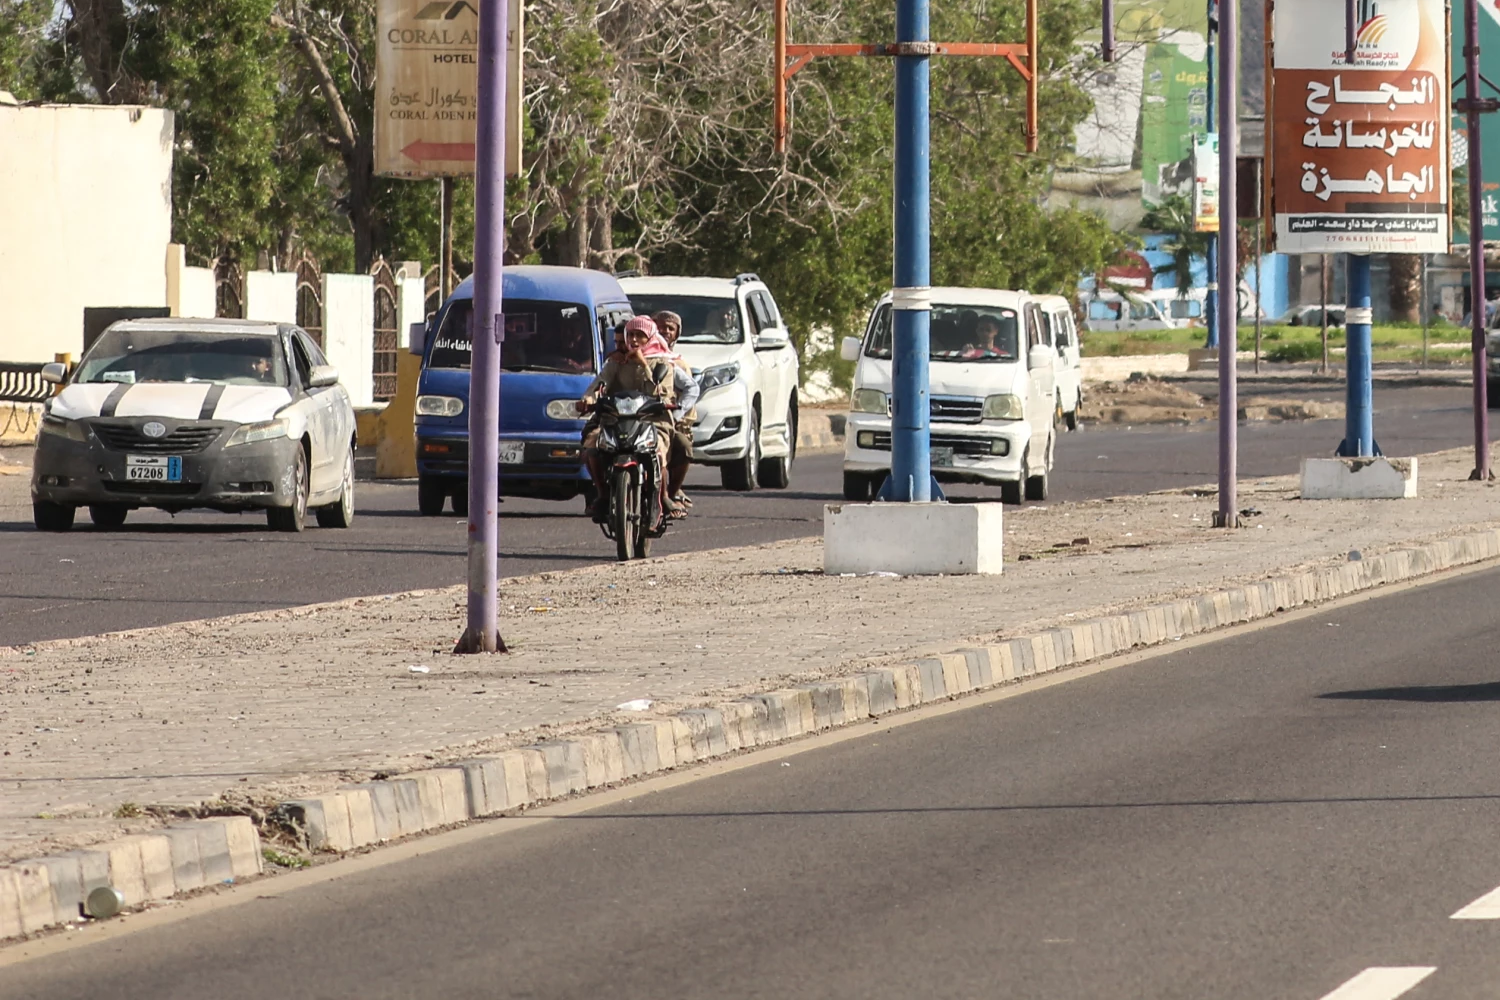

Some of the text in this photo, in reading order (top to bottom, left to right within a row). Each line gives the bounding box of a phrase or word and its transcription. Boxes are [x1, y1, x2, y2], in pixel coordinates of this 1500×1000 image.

[388, 29, 516, 45] CORAL AN
[433, 54, 477, 64] HOTEL
[389, 87, 421, 106] عدن
[425, 87, 467, 108] كورال
[1305, 74, 1434, 115] النجاح
[389, 110, 428, 121] CORAL
[432, 110, 465, 121] ADEN
[1302, 116, 1435, 157] للخرسانة
[1301, 161, 1434, 202] الجاهزة
[435, 337, 451, 349] الله
[130, 467, 164, 479] 67208
